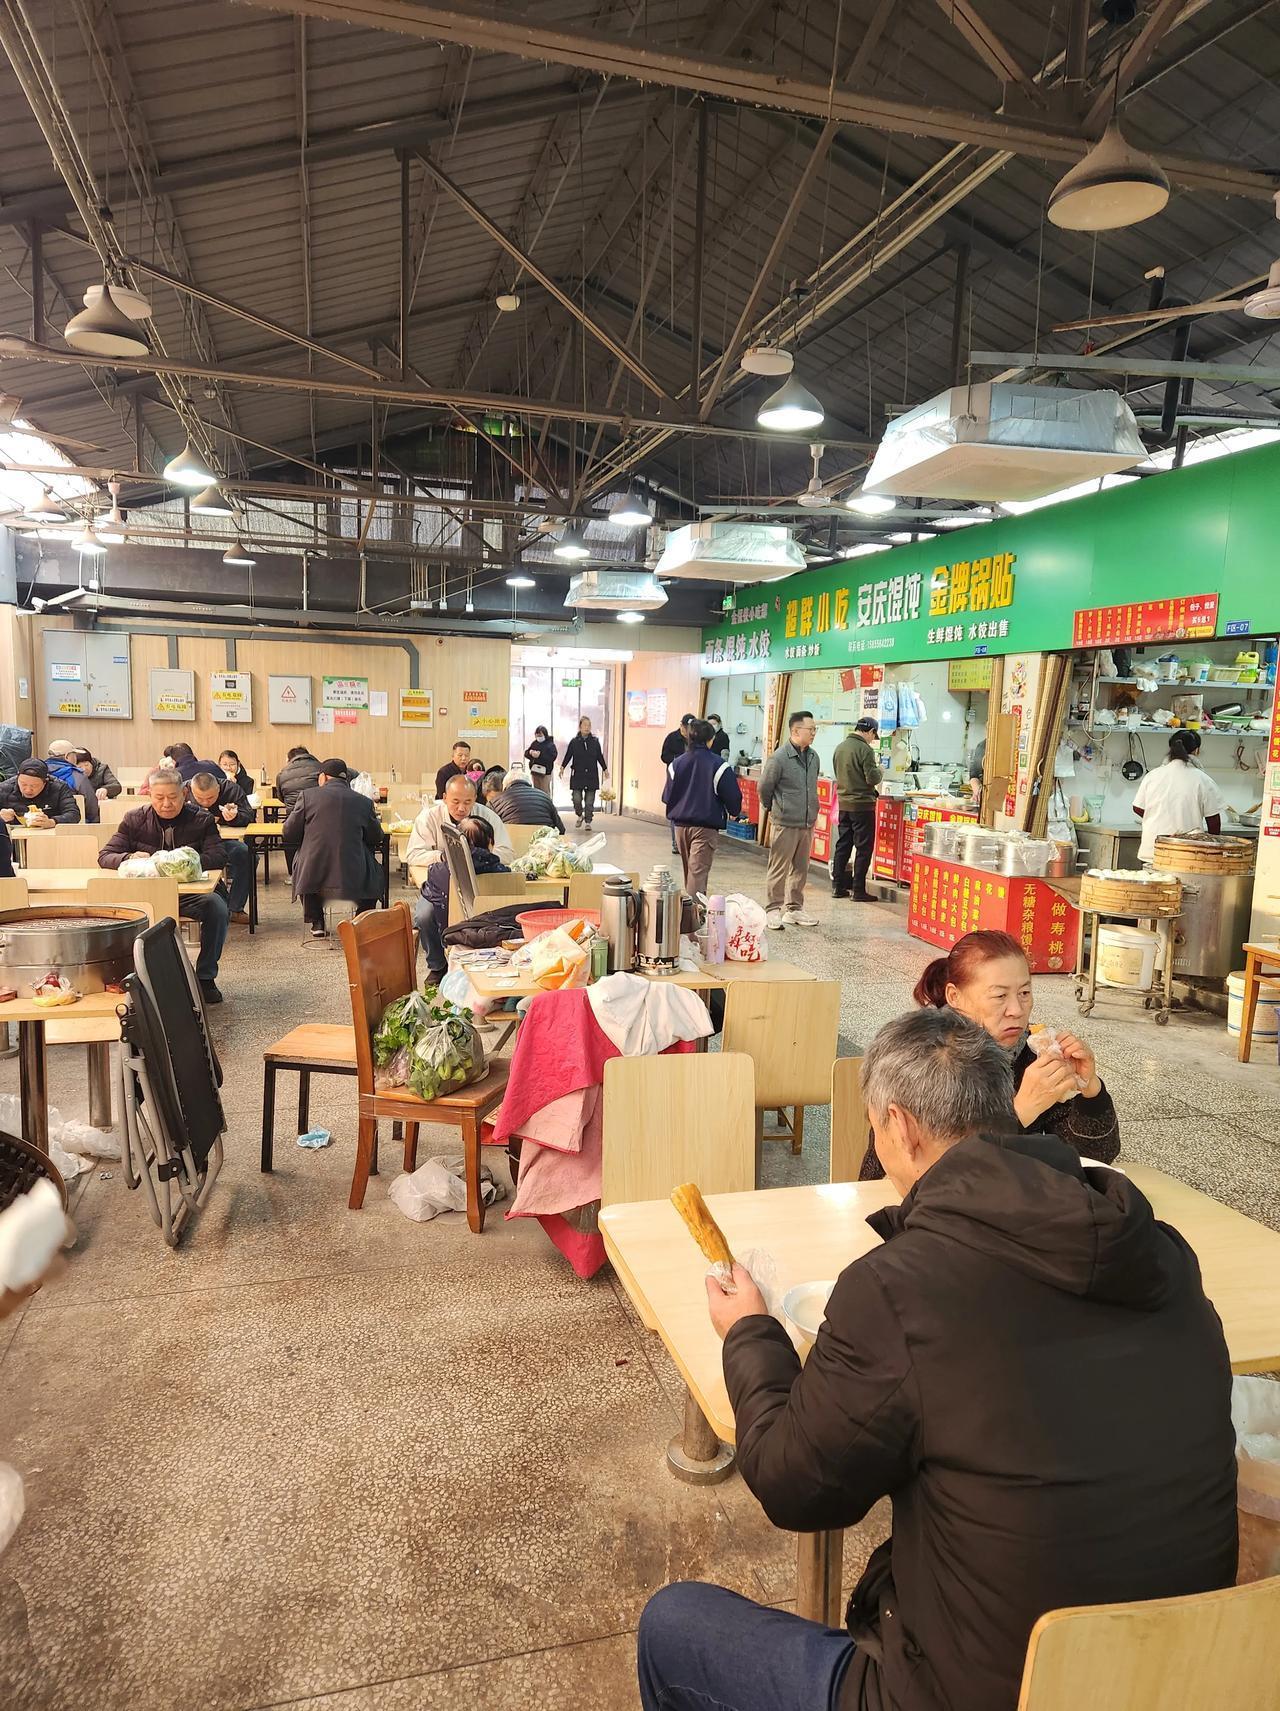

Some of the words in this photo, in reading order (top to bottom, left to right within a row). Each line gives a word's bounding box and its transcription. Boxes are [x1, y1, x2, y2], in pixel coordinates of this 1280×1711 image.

[857, 573, 922, 627] 安庆馄饨
[928, 552, 1016, 616] 金牌锅贴
[749, 629, 770, 658] 水饺
[927, 627, 964, 644] 生鲜馄饨
[968, 619, 1009, 640] 水饺出售
[1227, 623, 1249, 633] F区-07
[950, 872, 960, 928] 鲜肉大包
[1048, 893, 1067, 954] 做寿桃
